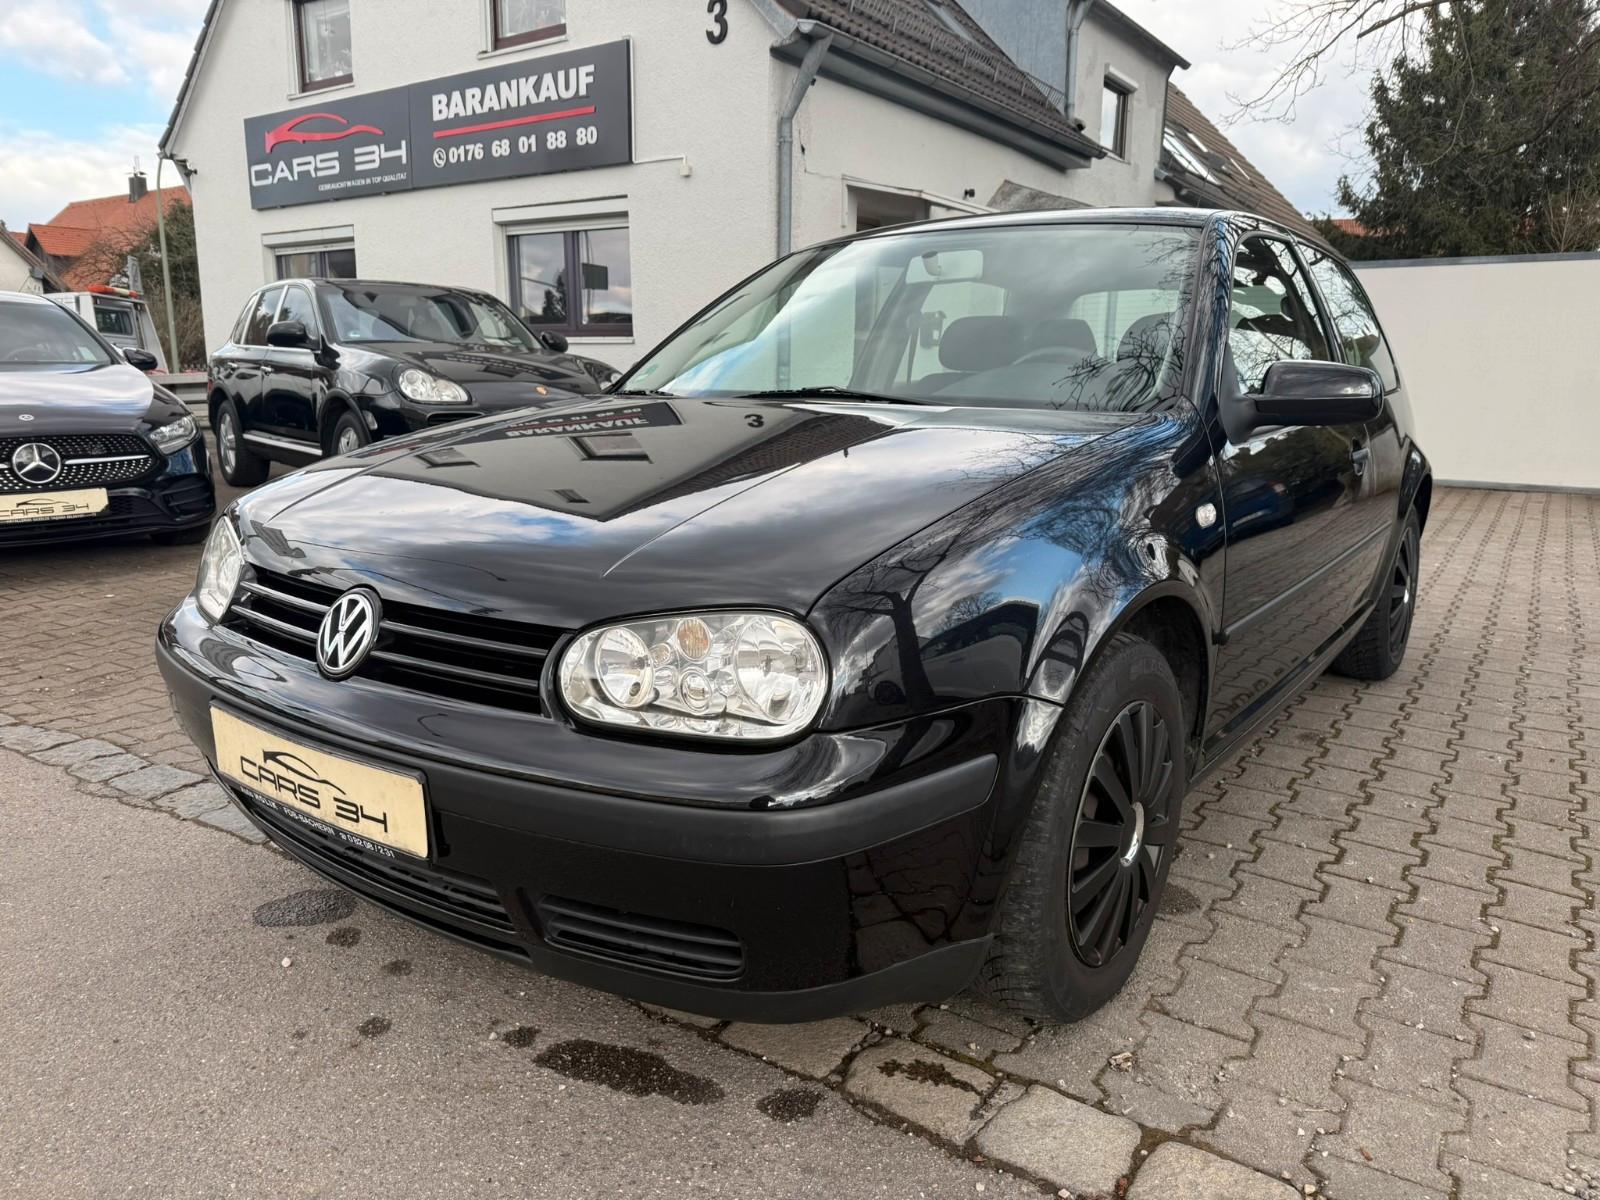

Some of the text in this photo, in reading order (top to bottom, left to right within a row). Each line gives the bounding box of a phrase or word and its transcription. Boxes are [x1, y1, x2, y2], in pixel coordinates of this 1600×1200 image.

[706, 0, 728, 45] 3
[432, 64, 595, 121] BARANKAUF
[250, 140, 407, 187] CARS 34
[449, 126, 598, 163] 0176 68 01 88 80
[372, 175, 382, 185] TOP
[240, 756, 321, 809] CARS
[333, 797, 388, 833] 34
